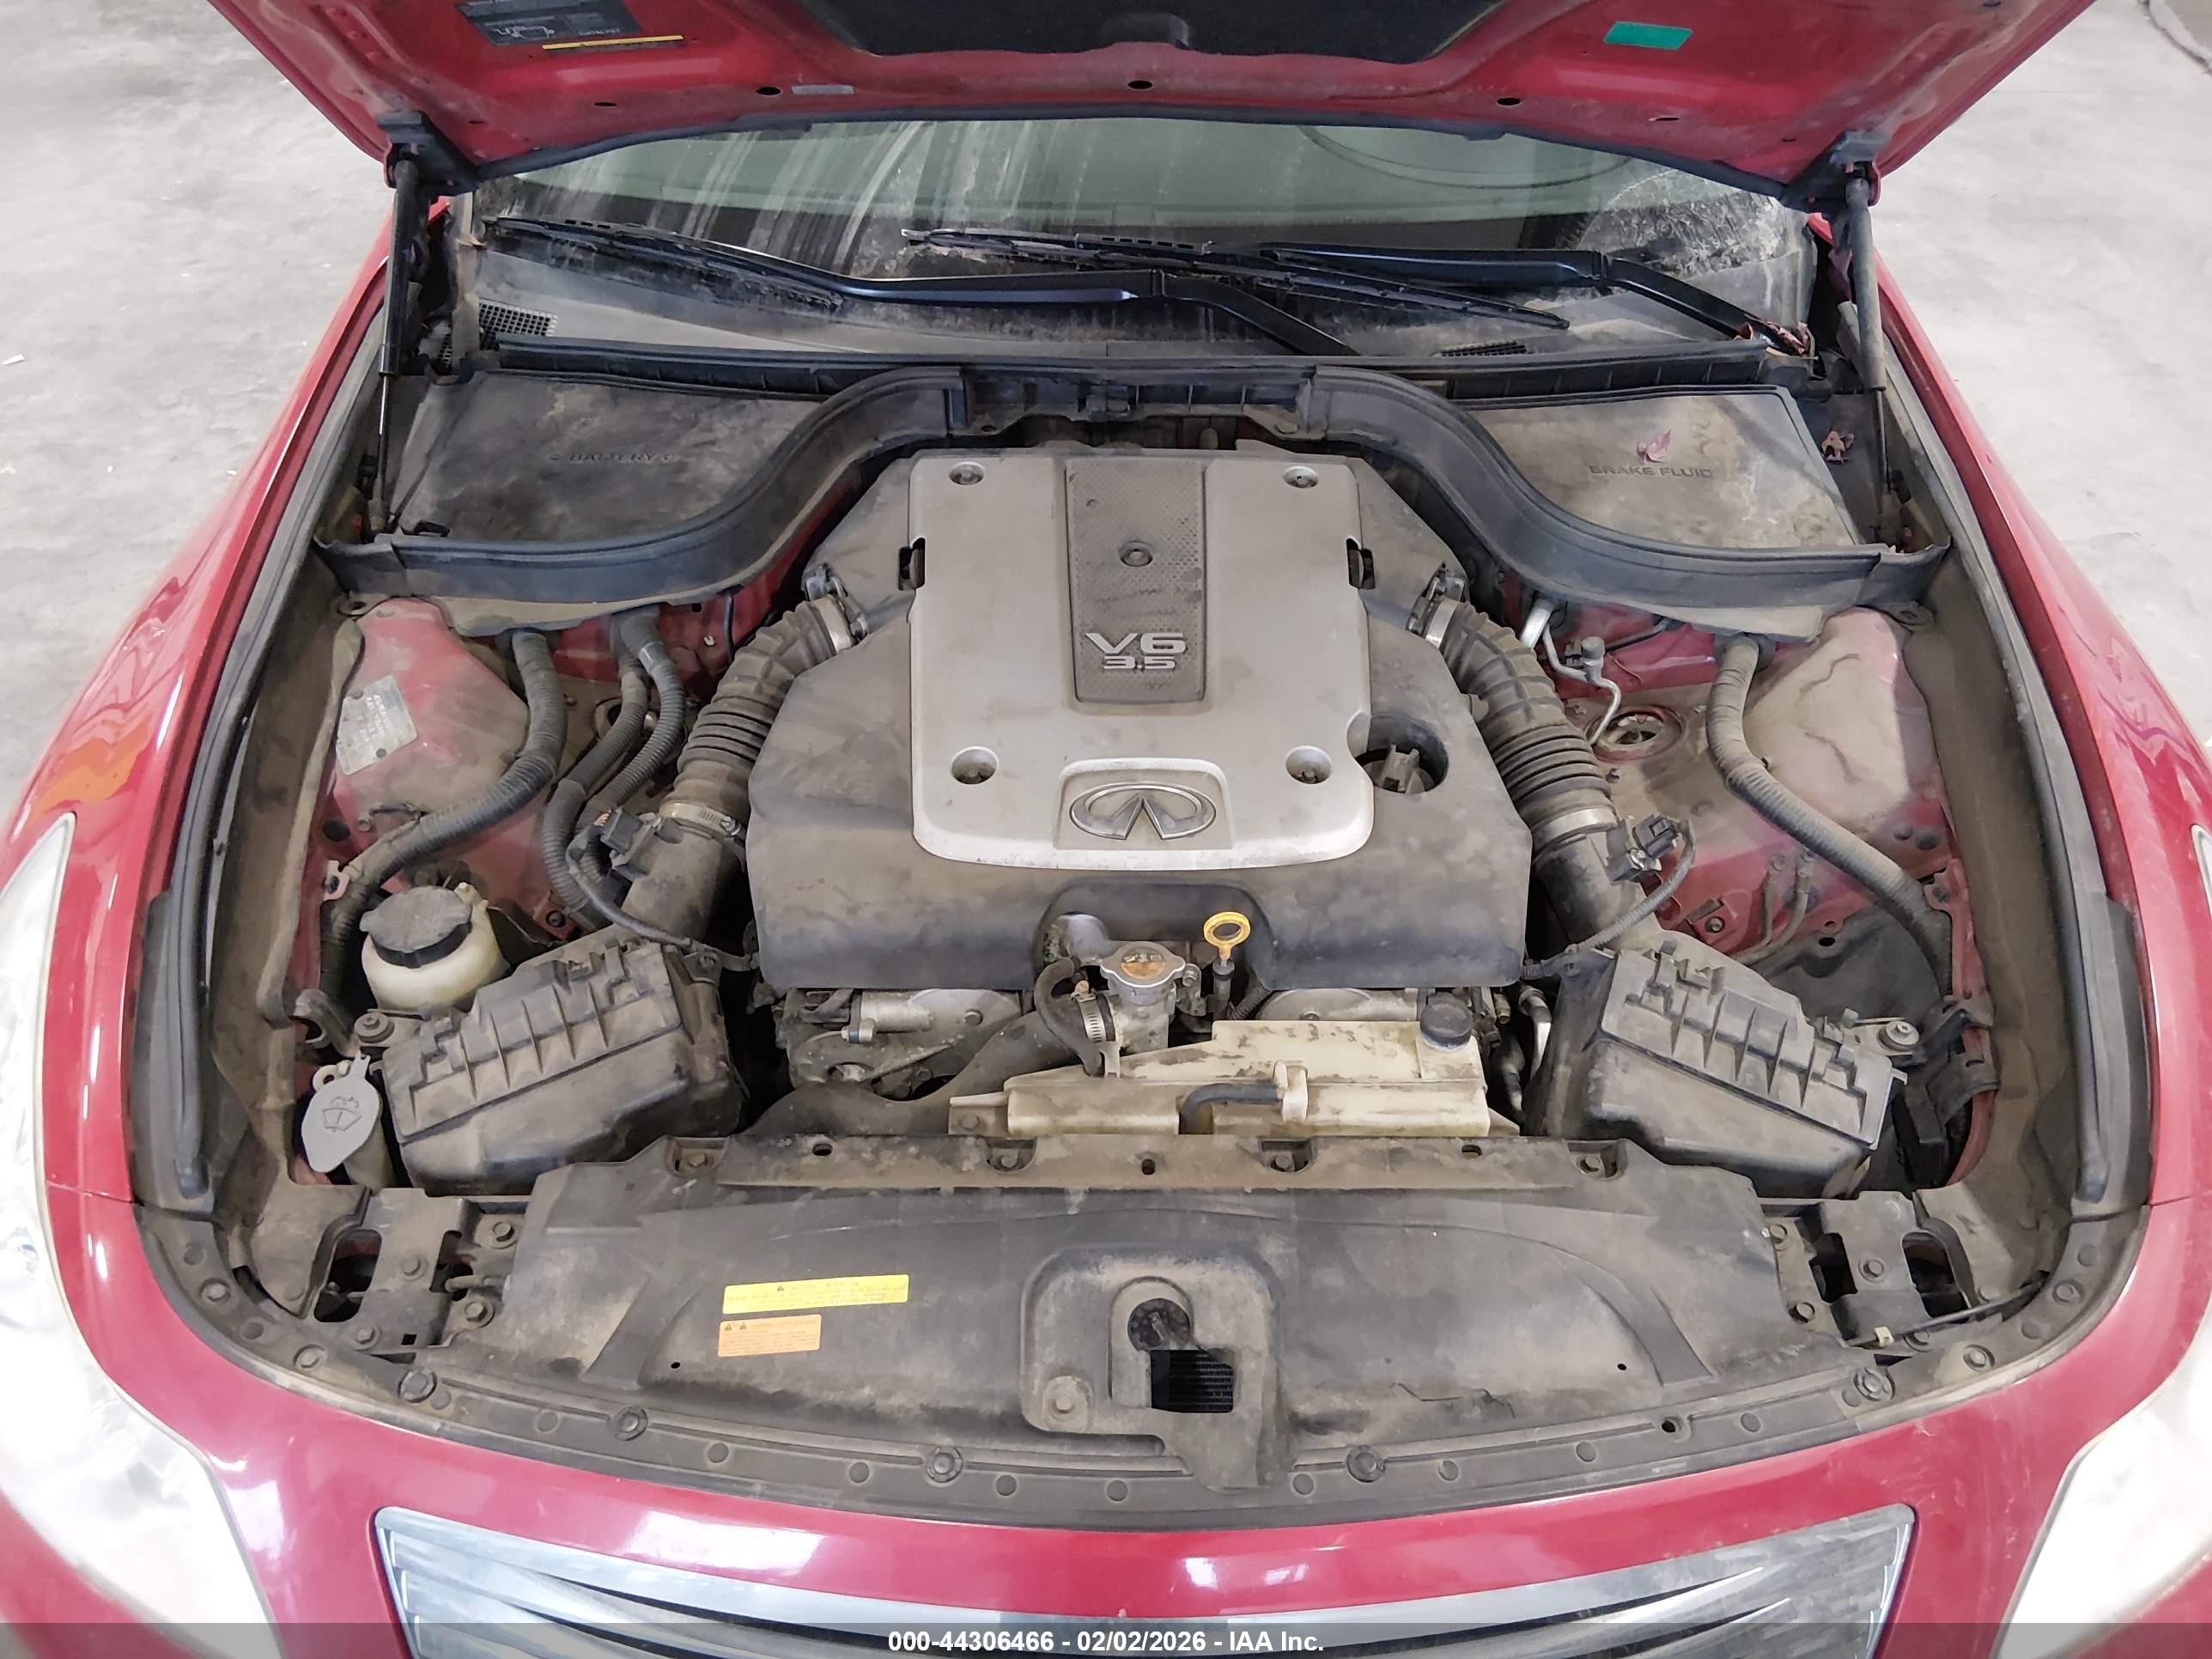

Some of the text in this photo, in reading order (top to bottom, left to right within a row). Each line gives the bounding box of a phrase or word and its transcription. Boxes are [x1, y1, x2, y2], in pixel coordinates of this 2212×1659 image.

[1589, 465, 1714, 478] BRAKE FLUID
[1085, 632, 1186, 654] V6
[1103, 655, 1176, 670] 3.5
